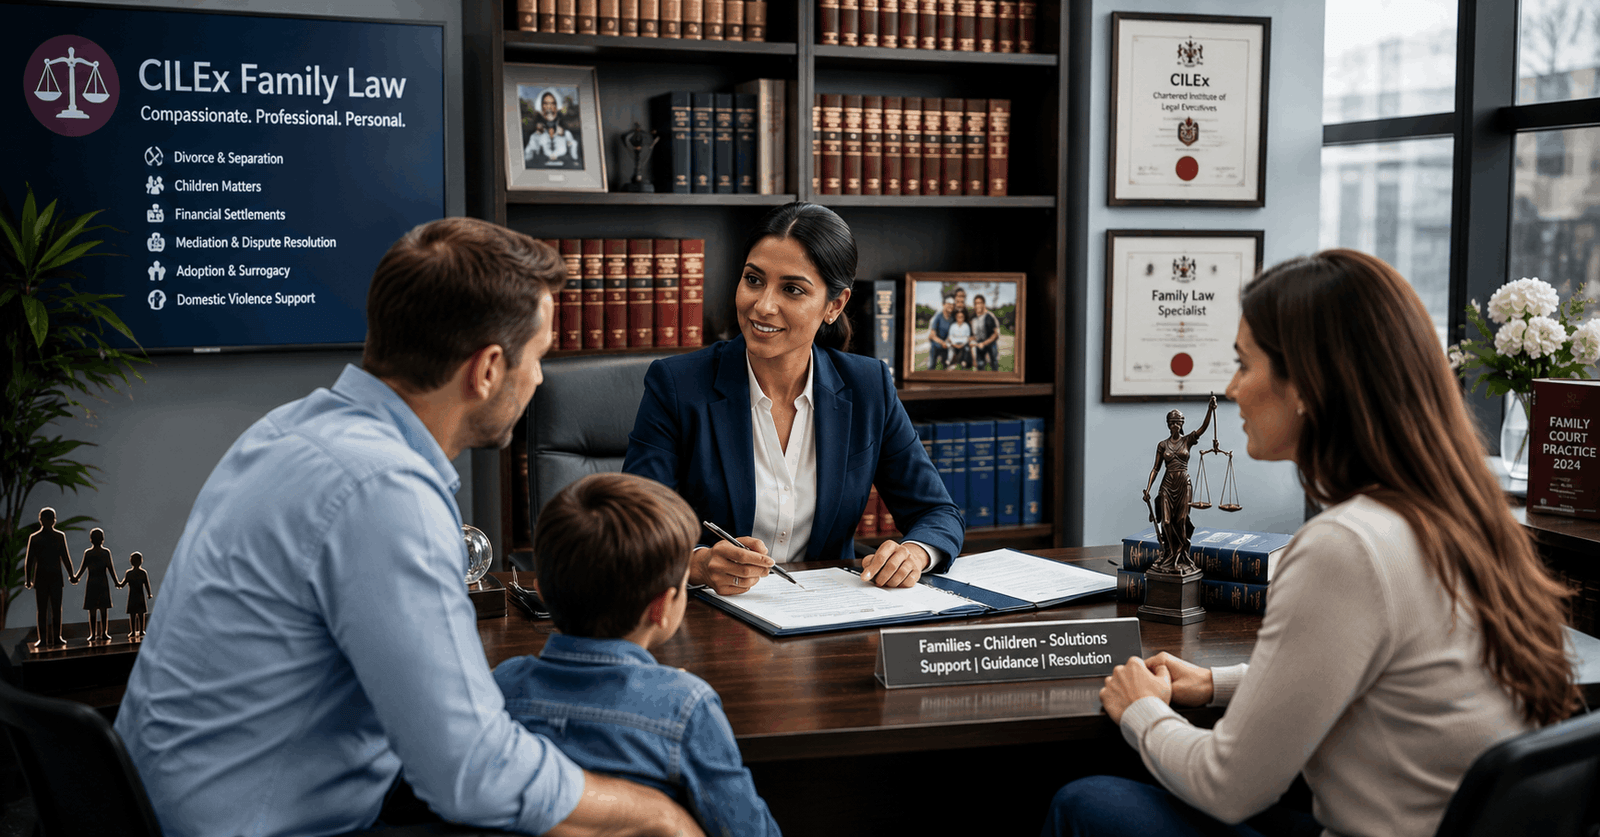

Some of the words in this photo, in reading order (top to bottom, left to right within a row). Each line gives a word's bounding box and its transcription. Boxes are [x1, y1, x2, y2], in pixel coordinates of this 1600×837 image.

[138, 58, 231, 93] CILEx
[241, 63, 339, 105] Family
[348, 67, 407, 99] Law
[1170, 73, 1210, 87] CILEx
[1153, 91, 1188, 100] Chartered
[1218, 93, 1227, 101] of
[140, 105, 252, 126] Compassionate.
[255, 108, 342, 126] Professional.
[345, 111, 406, 128] Personal.
[174, 150, 215, 164] Divorce
[217, 151, 226, 164] &
[228, 151, 284, 167] Separation
[174, 179, 219, 193] Children
[221, 179, 262, 193] Matters
[175, 207, 222, 221] Financial
[223, 207, 286, 221] Settlements
[175, 235, 229, 249] Mediation
[230, 235, 240, 249] &
[241, 235, 282, 251] Dispute
[283, 235, 337, 249] Resolution
[176, 264, 226, 280] Adoption
[227, 264, 237, 277] &
[238, 264, 291, 280] Surrogacy
[177, 293, 226, 306] Domestic
[228, 292, 273, 305] Violence
[274, 291, 316, 307] Support
[1152, 289, 1189, 304] Family
[1192, 289, 1215, 301] Law
[1158, 305, 1206, 318] Specialist
[1549, 416, 1591, 429] FAMILY
[1549, 430, 1589, 443] COURT
[1542, 443, 1597, 458] PRACTICE
[1553, 458, 1581, 470] 2024
[919, 637, 972, 654] Families
[983, 634, 1037, 651] Children
[1048, 632, 1108, 647] Solutions
[920, 658, 972, 676] Support
[981, 655, 1039, 671] Guidance
[1048, 651, 1112, 667] Resolution
